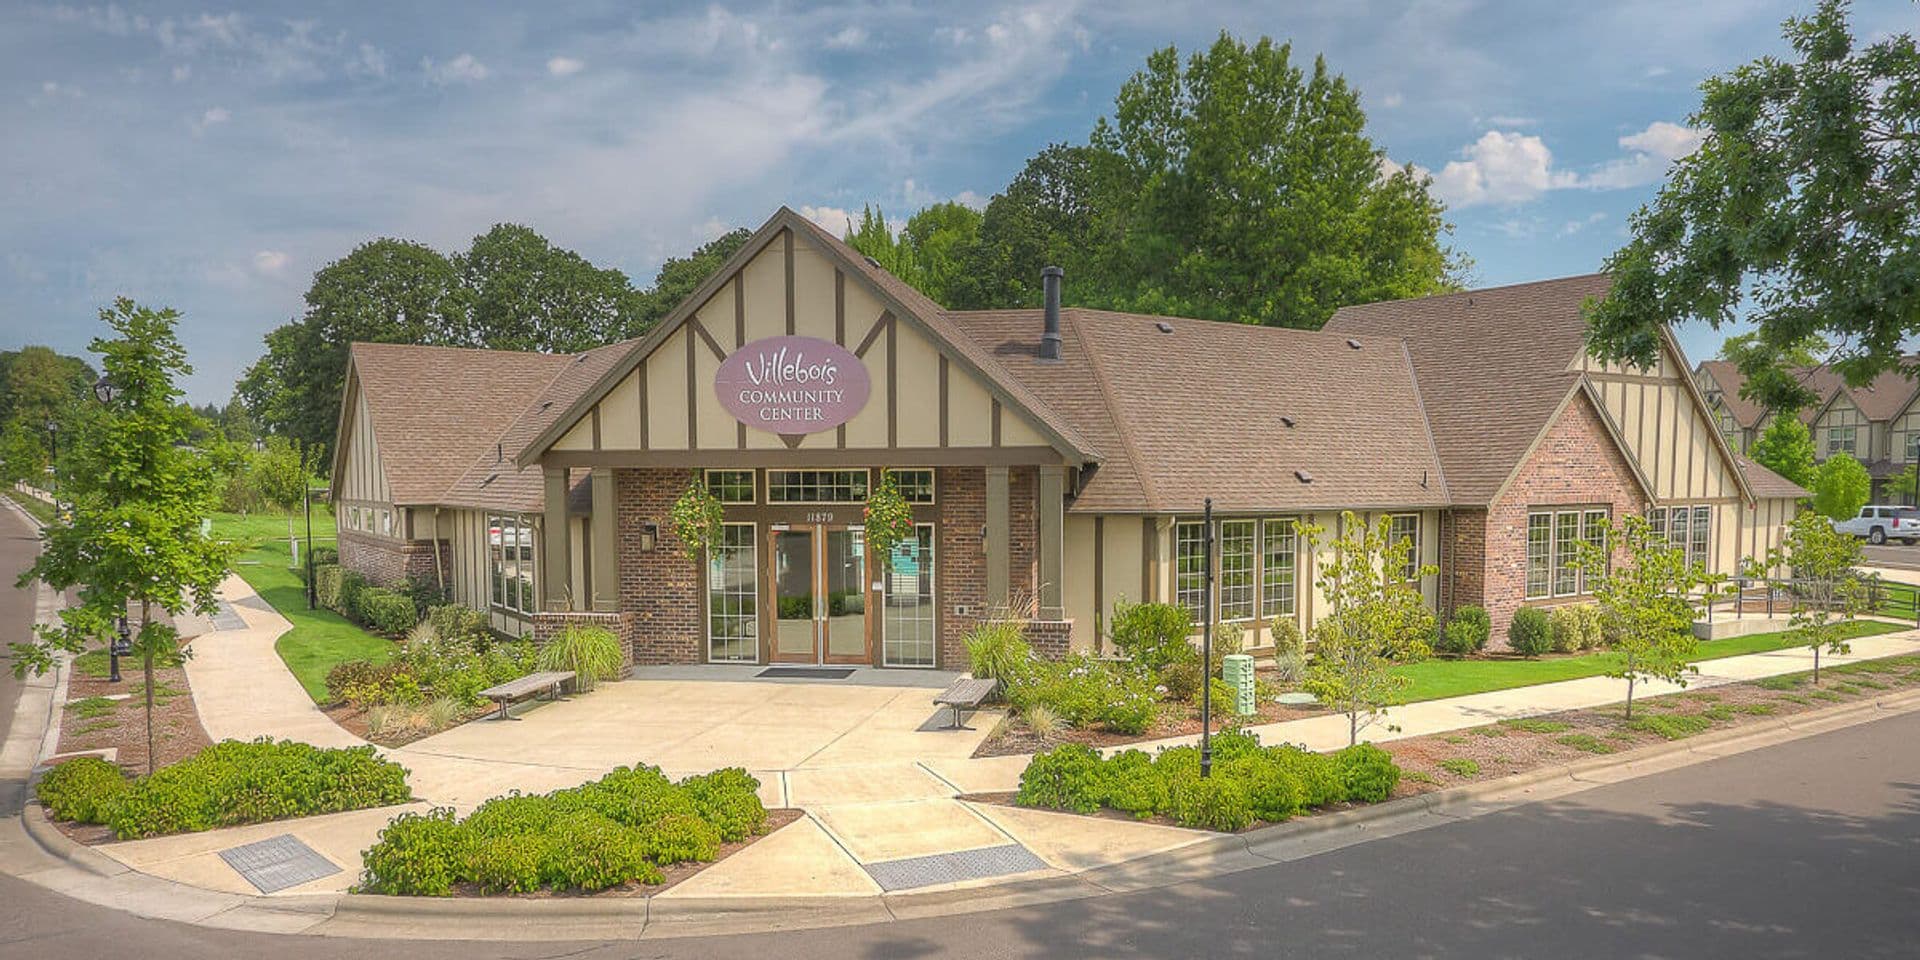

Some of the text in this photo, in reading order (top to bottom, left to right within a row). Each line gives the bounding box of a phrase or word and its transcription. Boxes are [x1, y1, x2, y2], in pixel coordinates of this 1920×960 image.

[745, 347, 837, 386] Villebois
[739, 390, 844, 403] COMMUNITY
[759, 407, 824, 421] CENTER
[807, 512, 833, 522] 11879
